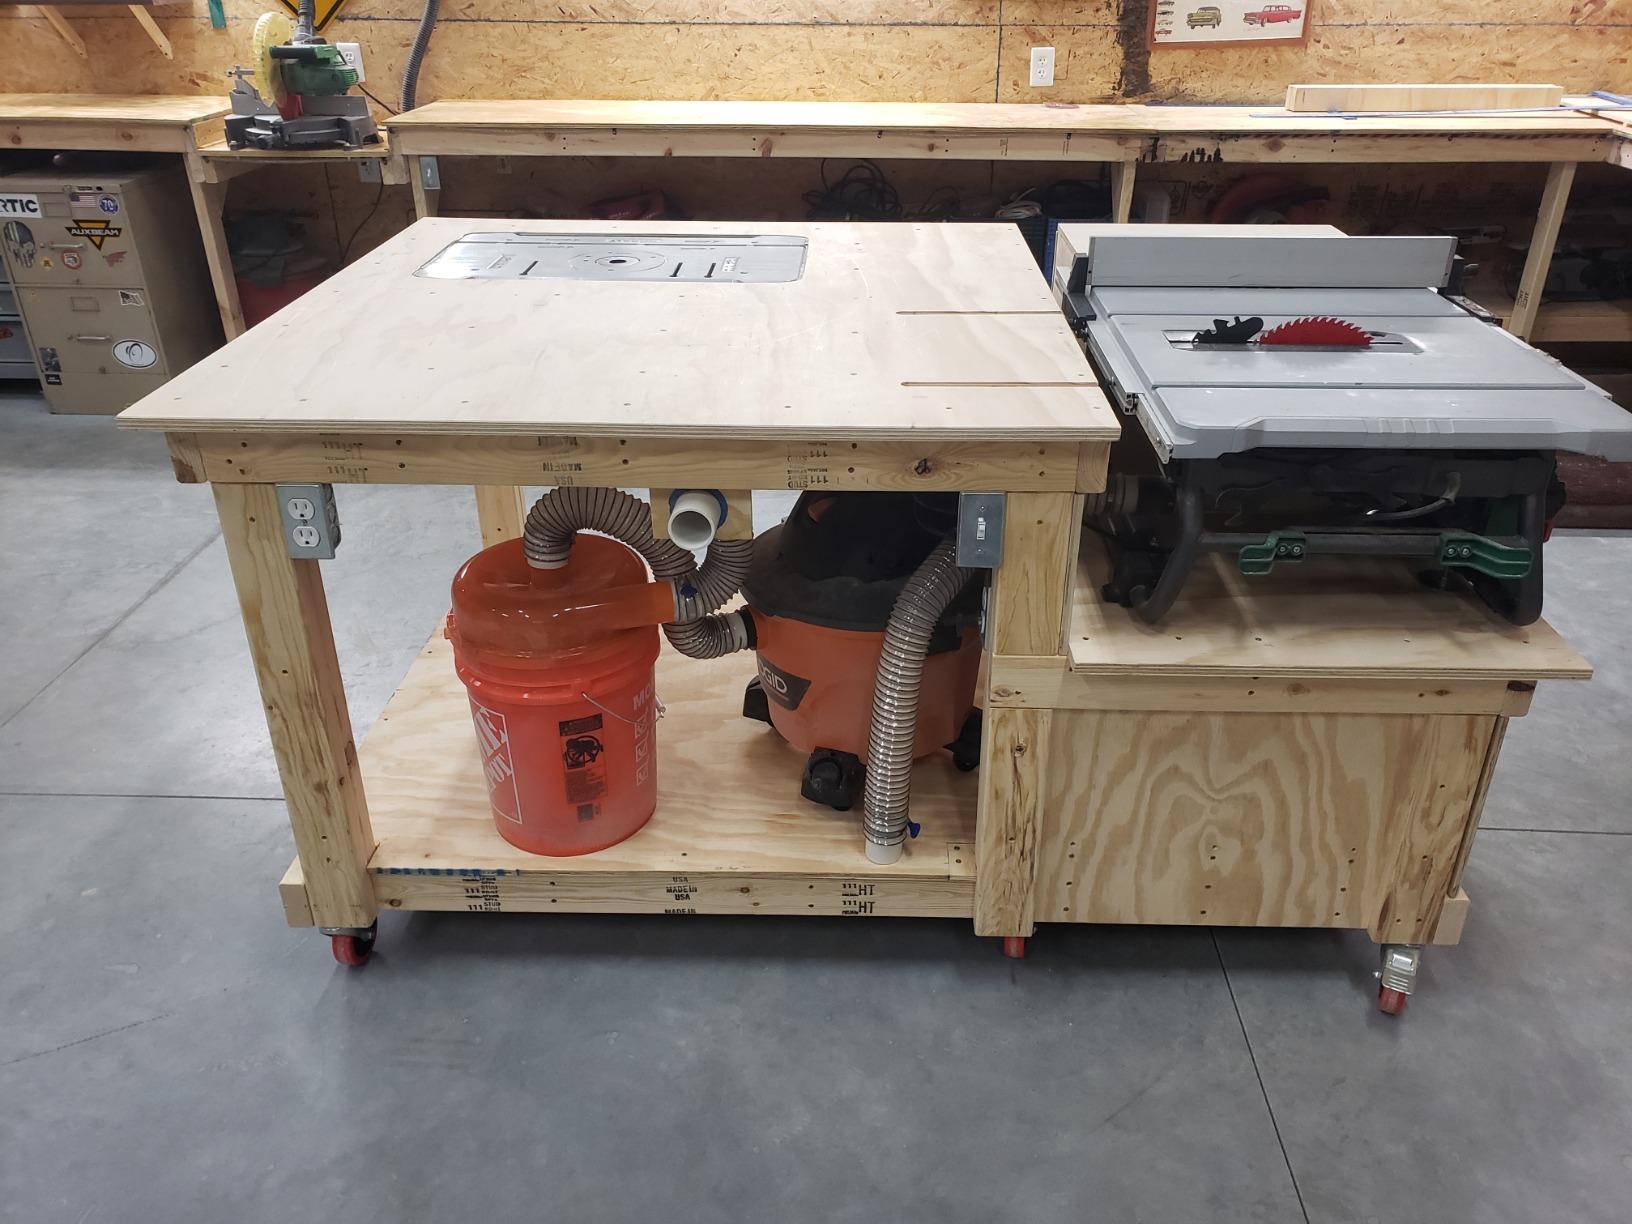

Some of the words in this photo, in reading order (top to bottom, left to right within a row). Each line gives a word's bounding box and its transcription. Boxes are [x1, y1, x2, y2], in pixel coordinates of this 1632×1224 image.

[859, 884, 876, 896] HT
[675, 893, 690, 901] USA
[859, 901, 876, 914] HT
